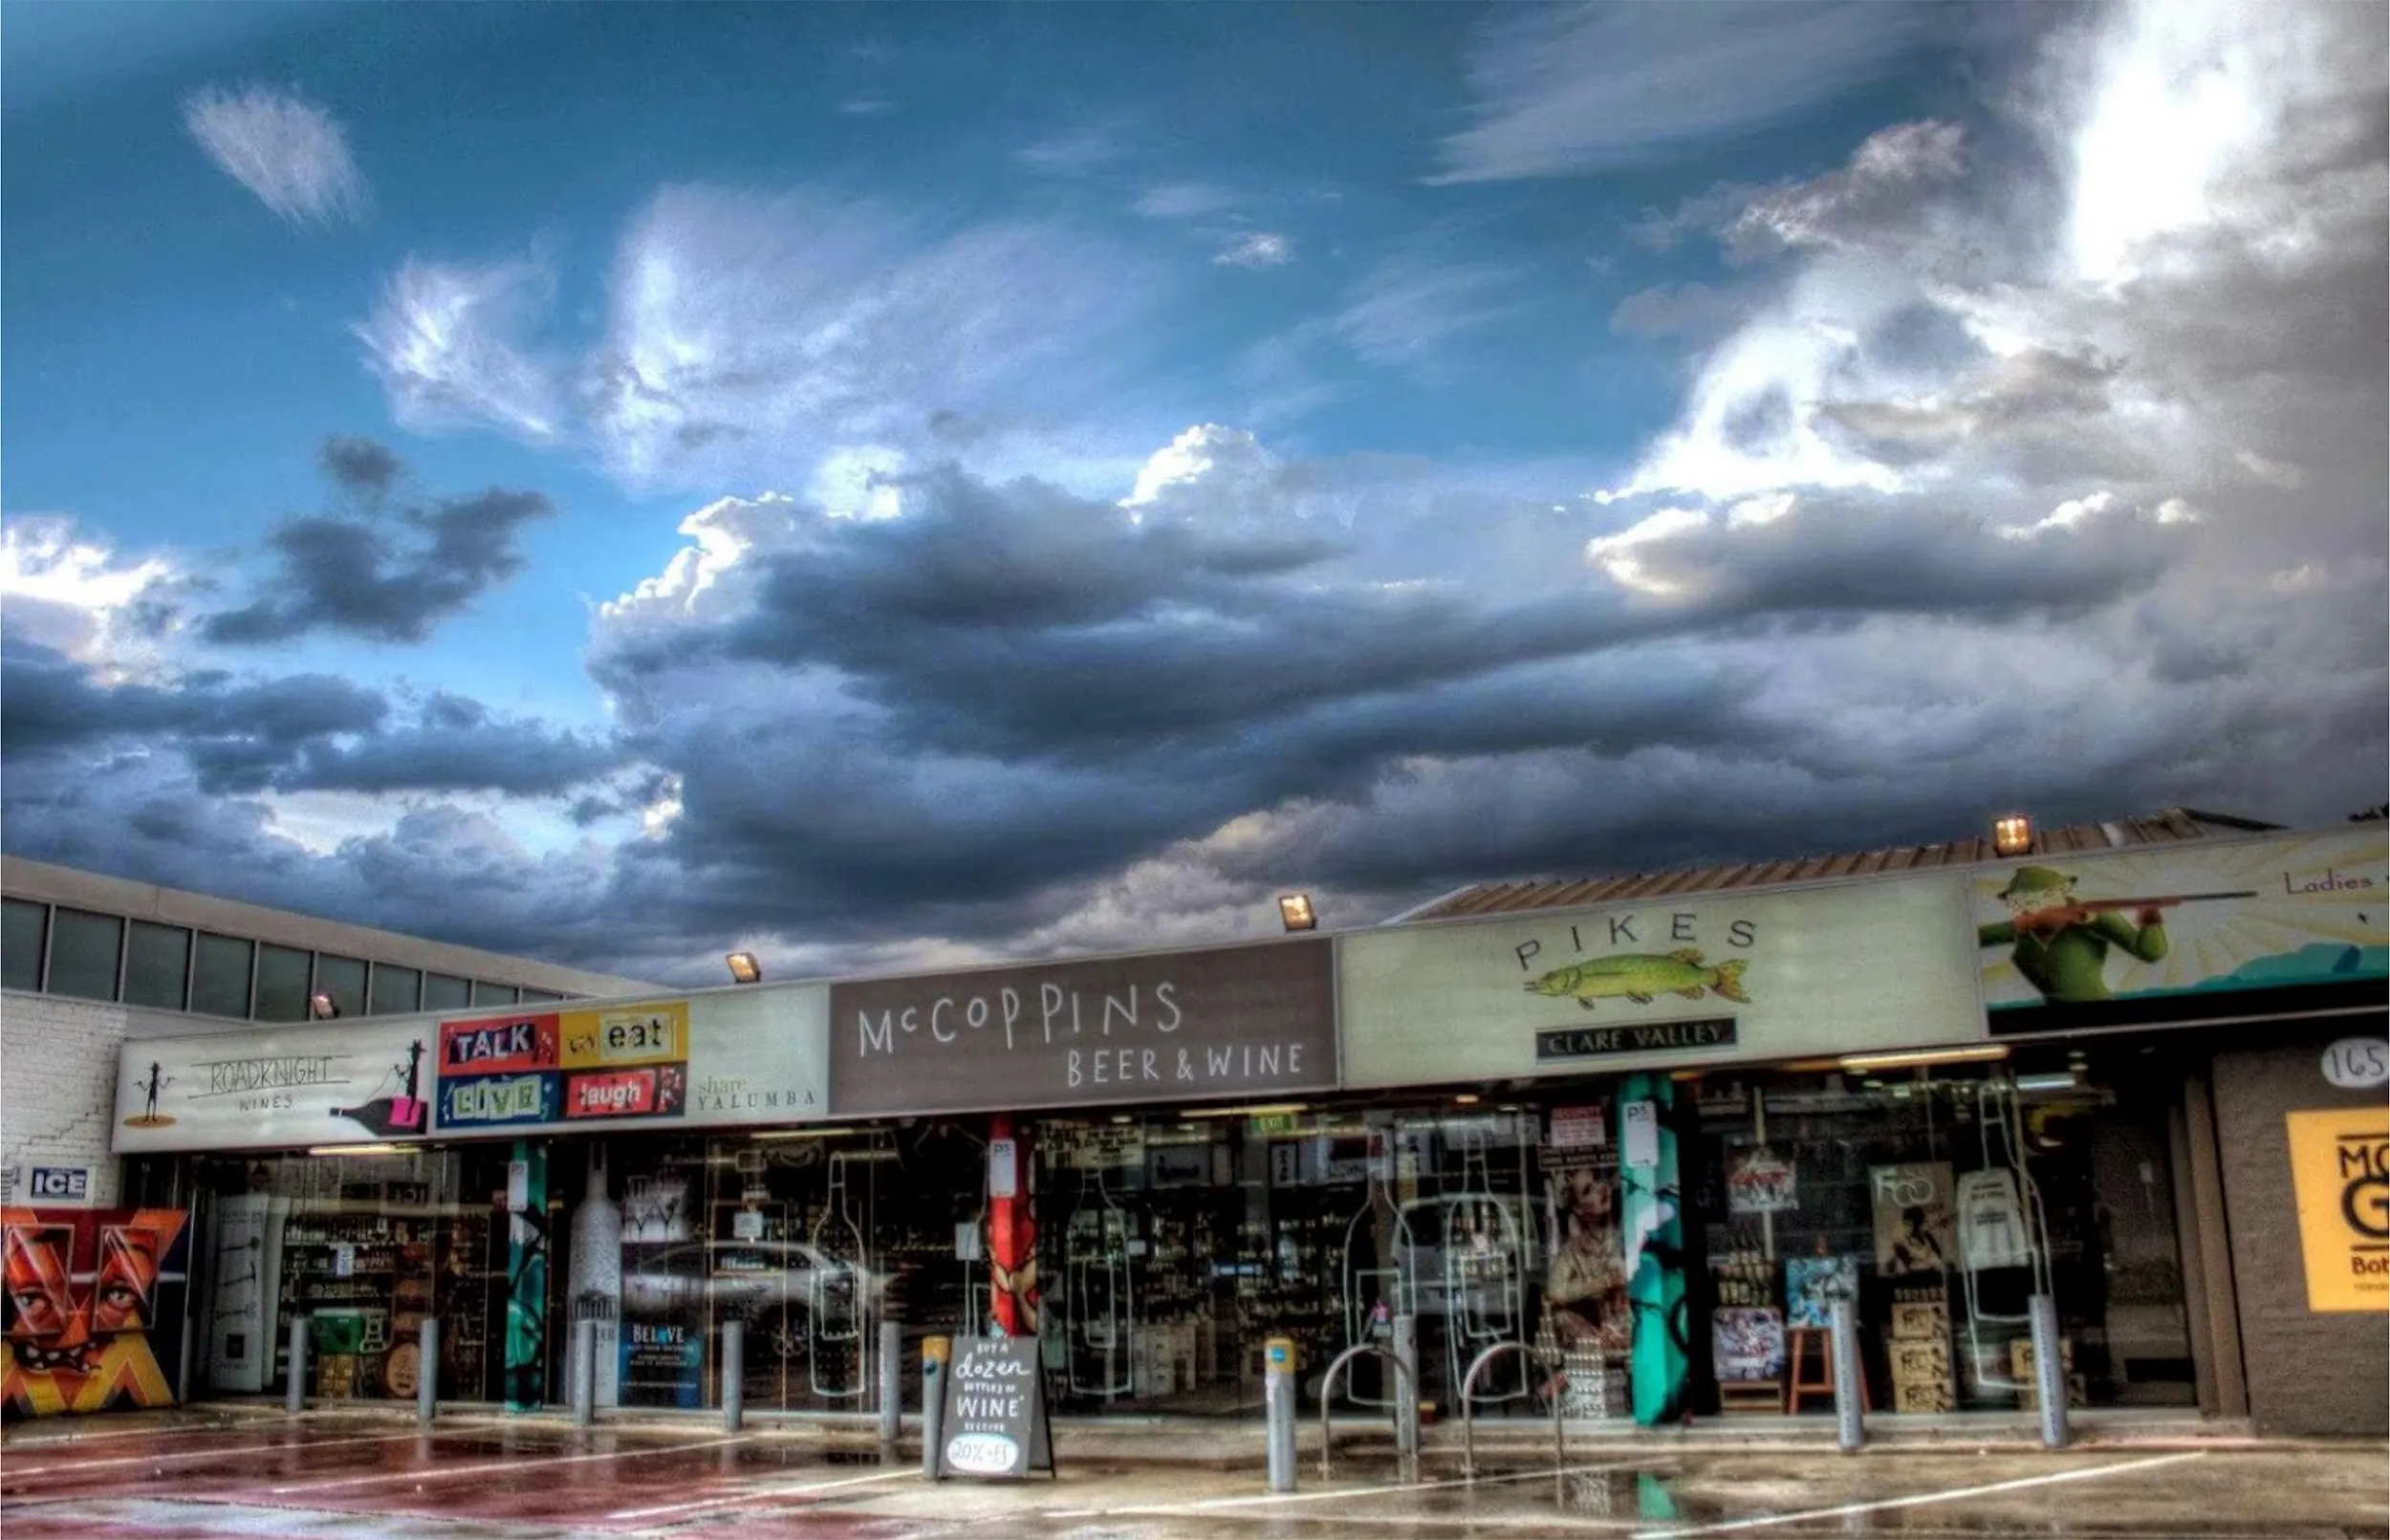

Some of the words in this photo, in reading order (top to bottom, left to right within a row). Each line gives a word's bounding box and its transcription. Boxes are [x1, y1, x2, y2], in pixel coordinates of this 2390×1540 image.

[2282, 868, 2374, 895] Ladies
[1514, 912, 1757, 972] PIKES
[456, 1024, 530, 1063] TALK
[608, 1017, 662, 1048] eat
[1546, 1031, 1623, 1053] CLARE
[1634, 1024, 1722, 1048] VALLEY
[211, 1055, 333, 1095] ROADKNIGHT
[1067, 1048, 1161, 1088] BEER
[1176, 1048, 1194, 1081] &
[1206, 1044, 1303, 1077] WINE
[2331, 1046, 2384, 1079] 165
[239, 1095, 293, 1111] WINES
[455, 1082, 535, 1117] LIVE
[579, 1079, 641, 1109] laugh
[698, 1090, 815, 1111] YALUMBA
[34, 1172, 86, 1195] ICE
[956, 1352, 1031, 1378] dozen
[951, 1441, 985, 1463] 20%
